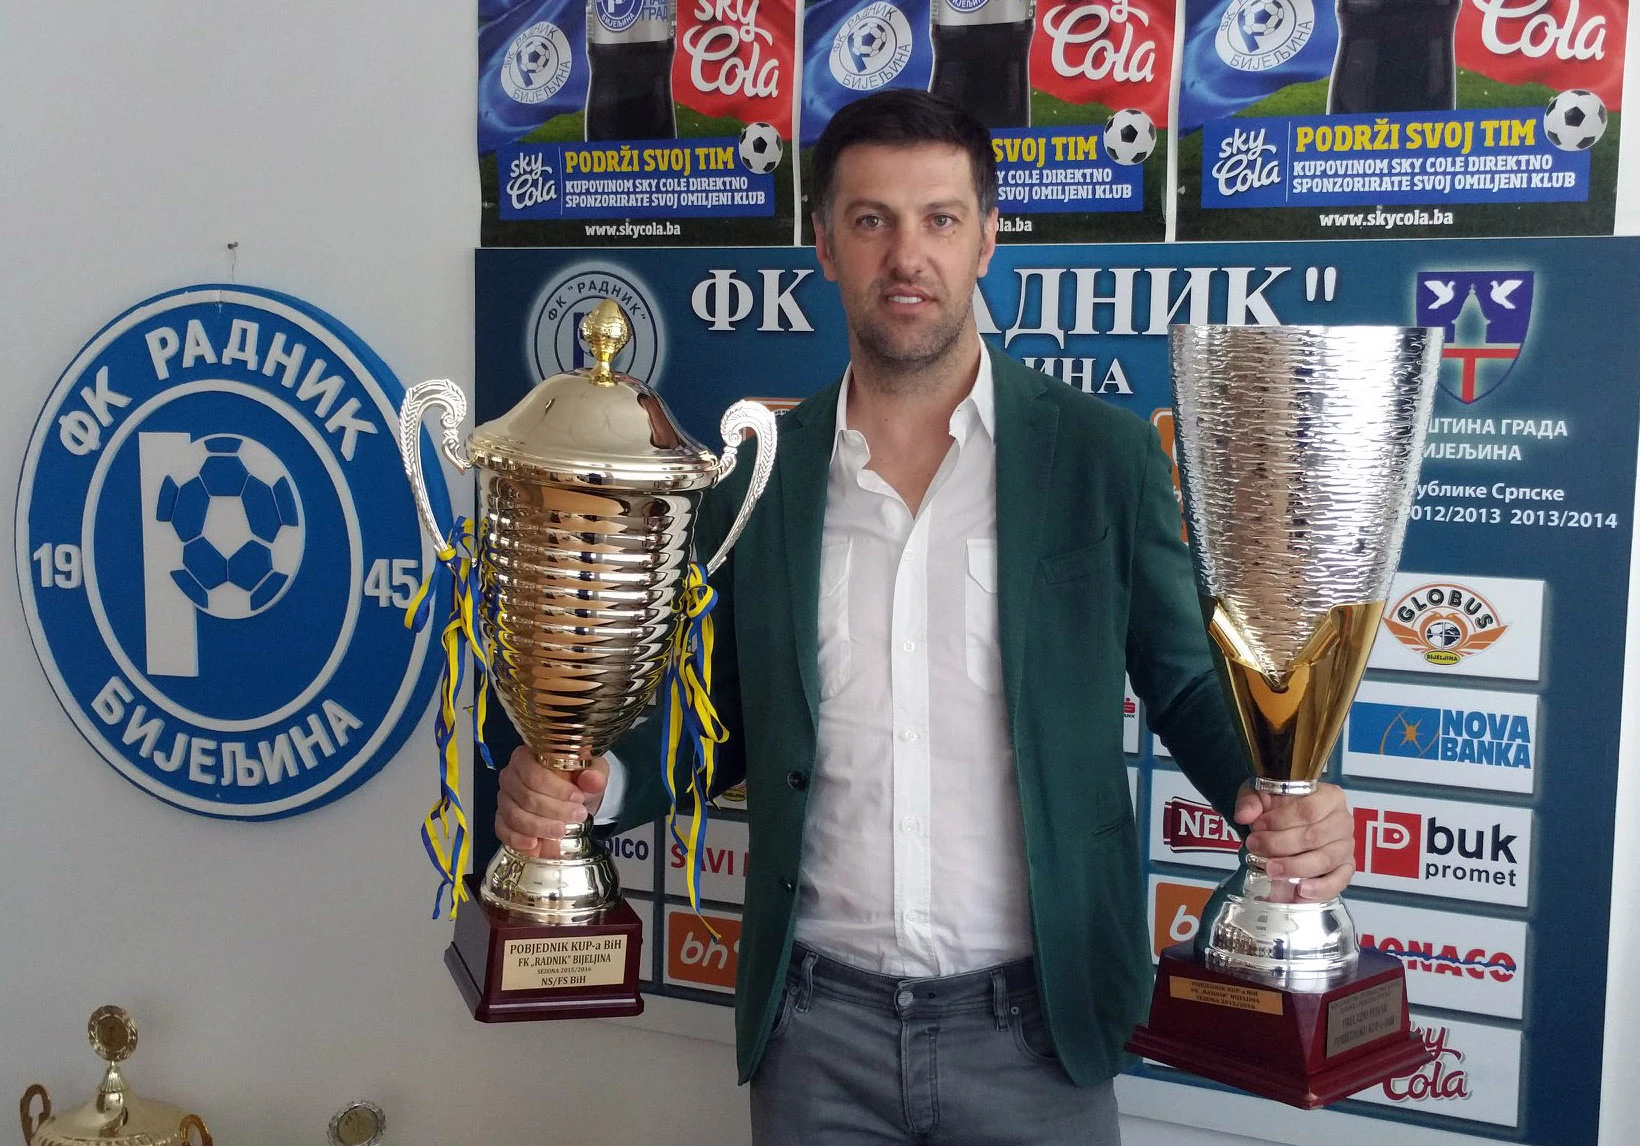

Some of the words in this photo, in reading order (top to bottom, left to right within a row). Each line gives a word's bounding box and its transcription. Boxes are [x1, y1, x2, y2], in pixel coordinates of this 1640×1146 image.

[847, 3, 898, 29] РАДНИК
[1473, 0, 1606, 60] Cola
[1042, 3, 1156, 83] Cola
[1230, 20, 1312, 70] БИЈЕЉИНА
[683, 25, 780, 98] Cola
[842, 43, 911, 90] БИЈЕЉИНА
[512, 60, 571, 103] БИЈЕЉИНА
[1219, 128, 1277, 158] sky
[1296, 118, 1400, 152] PODRŽI
[1405, 122, 1473, 154] SVOJ
[1480, 118, 1537, 147] TIM
[510, 153, 552, 179] sky
[565, 145, 639, 174] PODRŽI
[644, 149, 691, 176] SVOJ
[695, 147, 735, 170] TIM
[990, 137, 1046, 168] SVOJ
[1051, 135, 1098, 161] TIM
[1292, 158, 1389, 176] KUPOVINOM
[1391, 157, 1422, 173] SKY
[1425, 156, 1465, 173] COLE
[1467, 154, 1552, 172] DIREKTNO
[565, 179, 633, 193] KUPOVINOM
[635, 178, 658, 192] SKY
[659, 177, 687, 191] COLE
[689, 176, 748, 190] DIREKTNO
[1007, 169, 1040, 184] COLE
[1042, 168, 1112, 183] DIREKTNO
[1211, 157, 1281, 196] Cola
[1292, 174, 1411, 194] SPONZORIRATE
[1413, 174, 1451, 193] SVOJ
[1454, 173, 1529, 193] OMILJENI
[1531, 171, 1576, 188] KLUB
[506, 174, 557, 210] Cola
[565, 193, 650, 208] SPONZORIRATE
[651, 193, 678, 209] SVOJ
[680, 191, 732, 208] OMILJENI
[734, 191, 765, 204] KLUB
[998, 186, 1029, 203] SVOJ
[1032, 185, 1092, 202] OMILJENI
[1095, 184, 1132, 199] KLUB
[585, 222, 681, 238] www.skycola.ba
[1319, 208, 1454, 228] www.skycola.ba
[548, 295, 567, 321] ФК
[567, 280, 647, 320] "РАДНИК"
[690, 269, 815, 332] ФК
[972, 266, 1337, 349] АДНИК"
[58, 366, 132, 457] ФК
[144, 318, 379, 463] РАДНИК
[1428, 418, 1495, 435] ШТИНА
[1500, 420, 1568, 440] ГРАДА
[1423, 443, 1522, 461] ИЈЕЉИНА
[1417, 480, 1487, 499] ублике
[1491, 482, 1565, 503] Српске
[1411, 506, 1501, 524] 012/2013
[1510, 509, 1617, 528] 2013/2014
[33, 543, 82, 589] 19
[364, 558, 421, 608] 45
[1397, 588, 1494, 629] GLOBUS
[90, 674, 364, 788] БИЈЕЉИНА
[1442, 709, 1531, 743] NOVA
[1441, 737, 1531, 769] BANKA
[1426, 816, 1518, 864] buk
[1425, 862, 1517, 887] promet
[510, 942, 568, 955] POBJEDNIK
[571, 941, 601, 951] KUP-a
[603, 939, 622, 950] BiH
[518, 957, 529, 967] FK
[572, 953, 611, 965] BIJELJINA
[541, 976, 568, 987] NS/FS
[570, 975, 586, 985] BiH
[560, 966, 592, 974] 2015/2016
